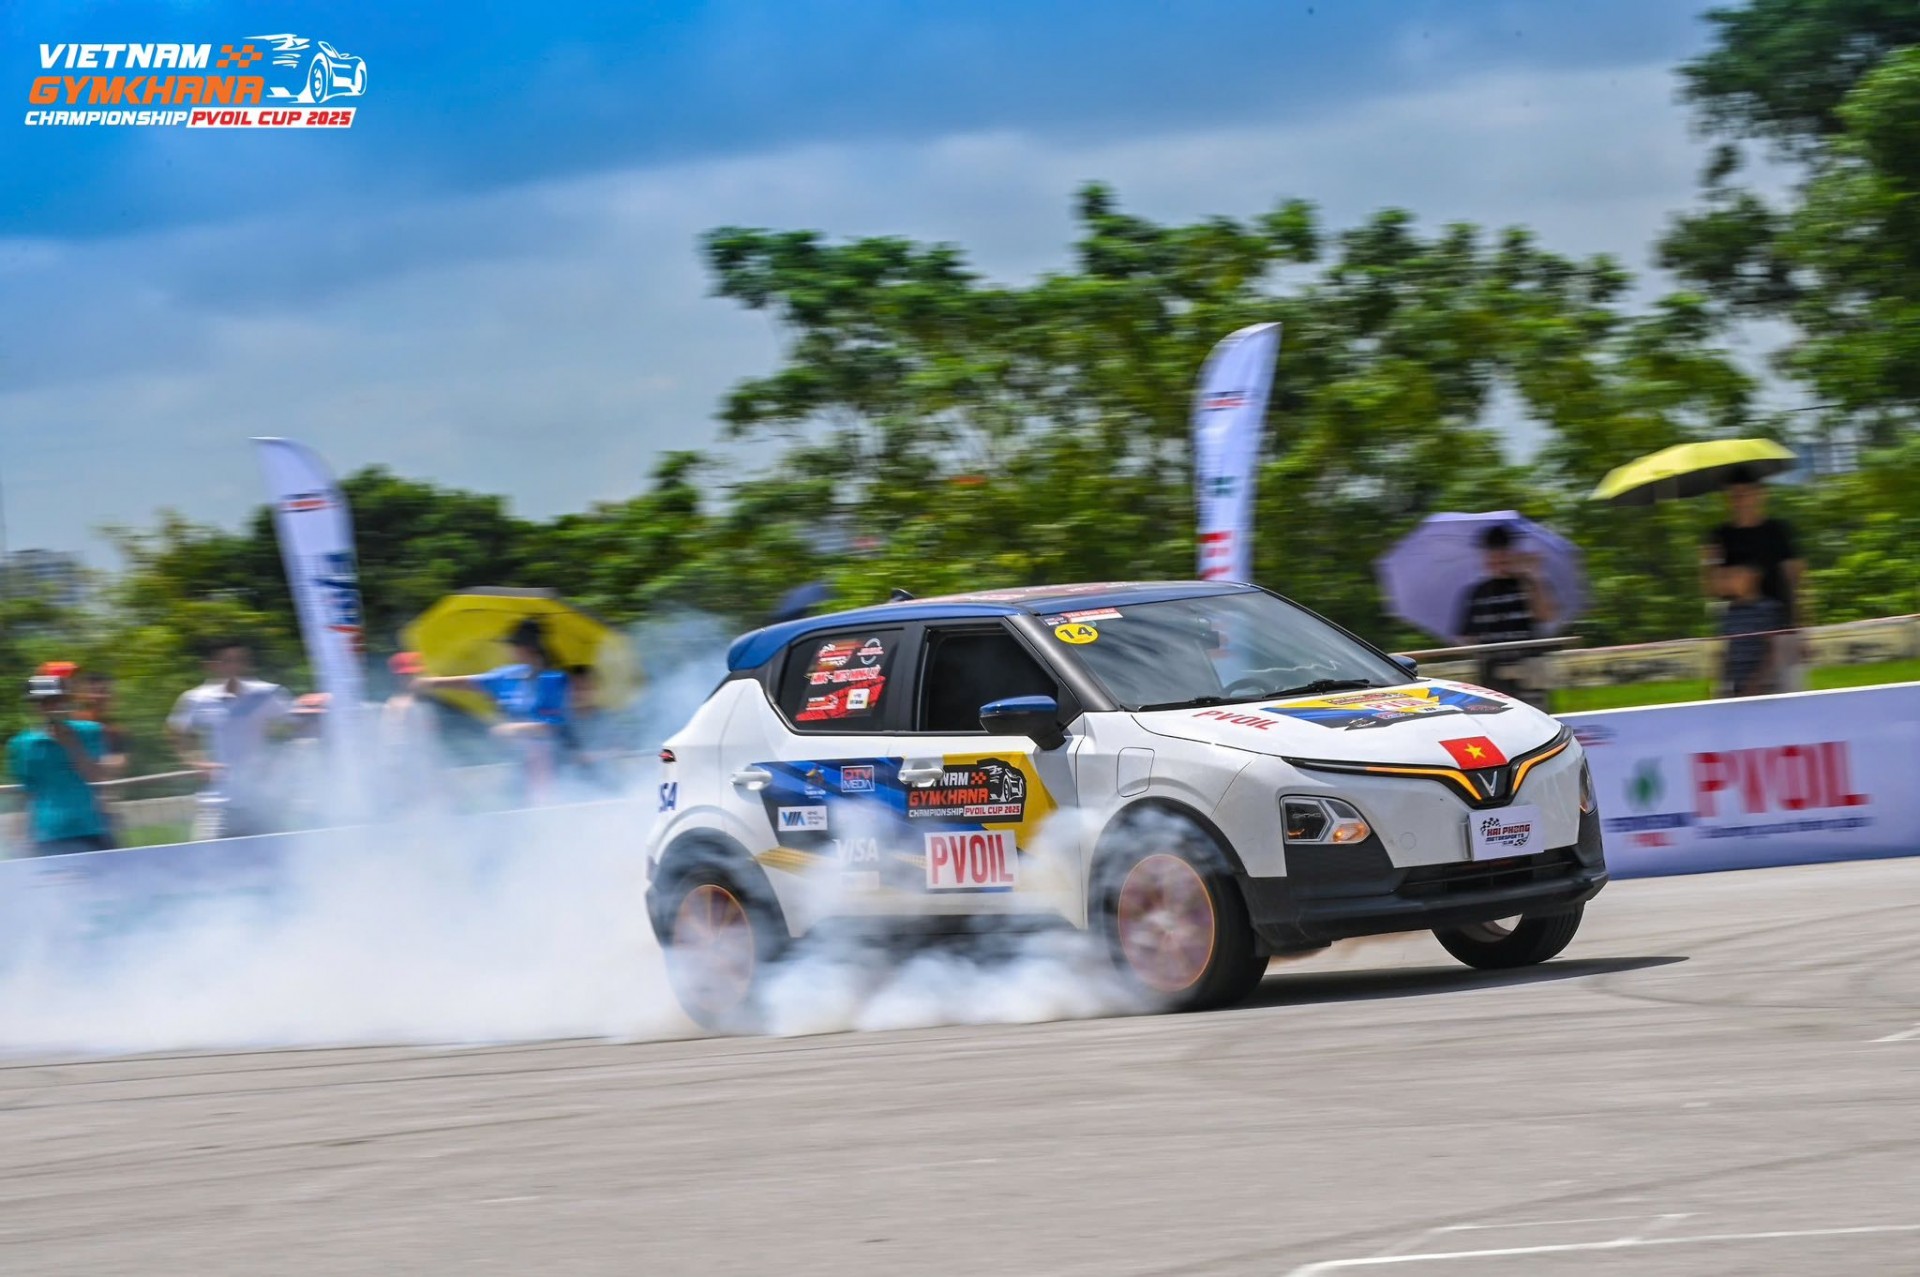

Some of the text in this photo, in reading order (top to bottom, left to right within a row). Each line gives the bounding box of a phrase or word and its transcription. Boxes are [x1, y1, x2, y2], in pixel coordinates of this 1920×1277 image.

[1060, 626, 1094, 640] 14
[1191, 710, 1279, 730] PVOIL
[909, 788, 989, 807] GYMKHANA
[908, 805, 1020, 817] CHAMPIONSHIP PVOIL CUP 2025
[1487, 824, 1530, 836] HAI PHONG
[832, 838, 879, 862] VISA
[931, 834, 1014, 885] PVOIL
